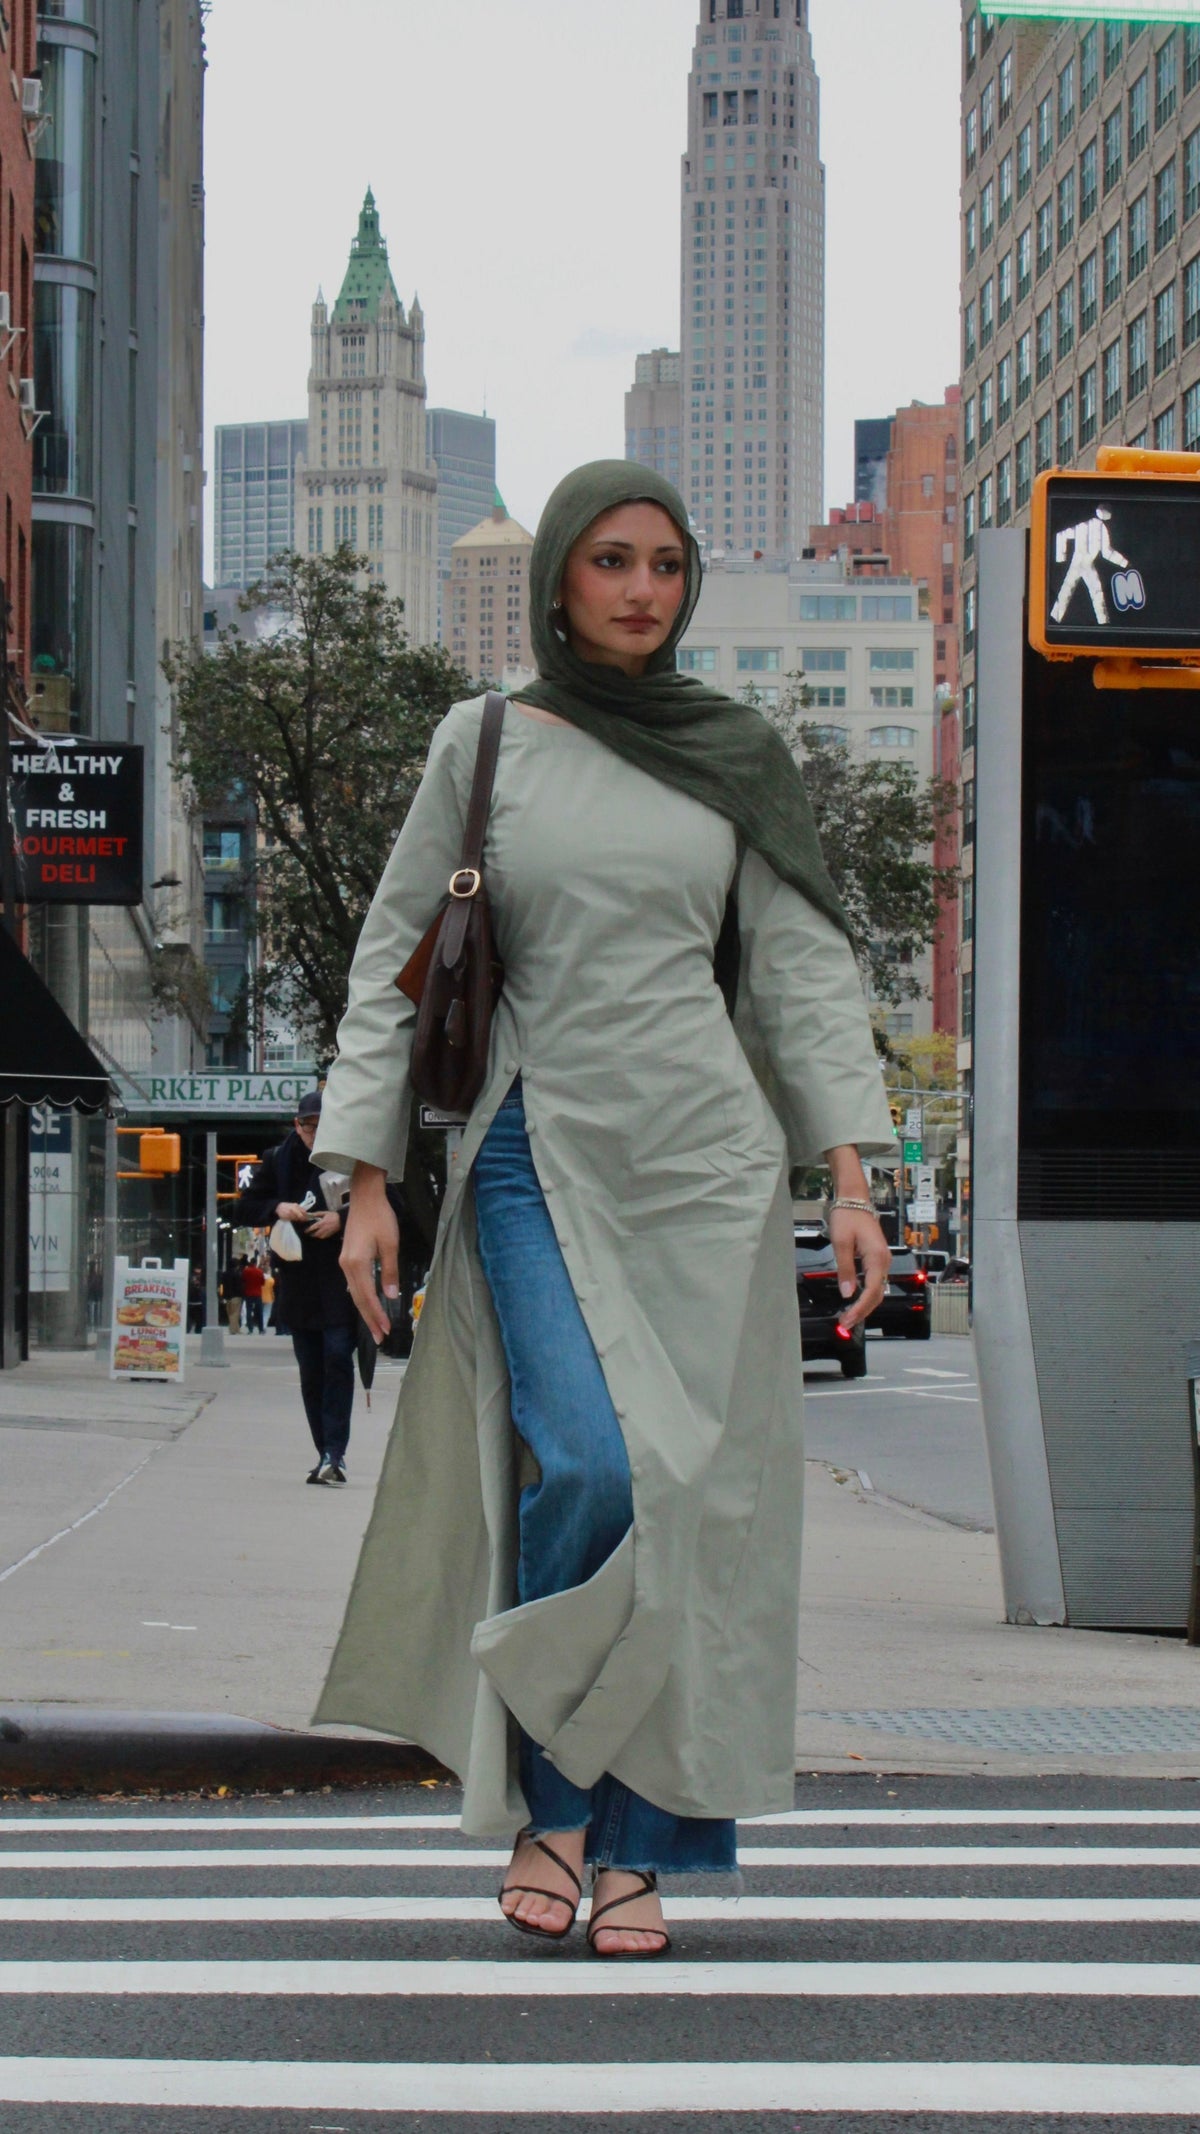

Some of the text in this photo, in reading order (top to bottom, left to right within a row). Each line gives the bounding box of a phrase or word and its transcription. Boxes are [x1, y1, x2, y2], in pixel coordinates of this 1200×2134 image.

[1111, 569, 1146, 611] M
[12, 755, 123, 775] HEALTHY
[58, 783, 75, 802] &
[26, 809, 106, 829] FRESH
[41, 863, 96, 883] DELI
[228, 1079, 309, 1102] PLACE
[909, 1121, 923, 1130] 20
[124, 1284, 176, 1298] BREAKFAST
[131, 1327, 167, 1338] LUNCH
